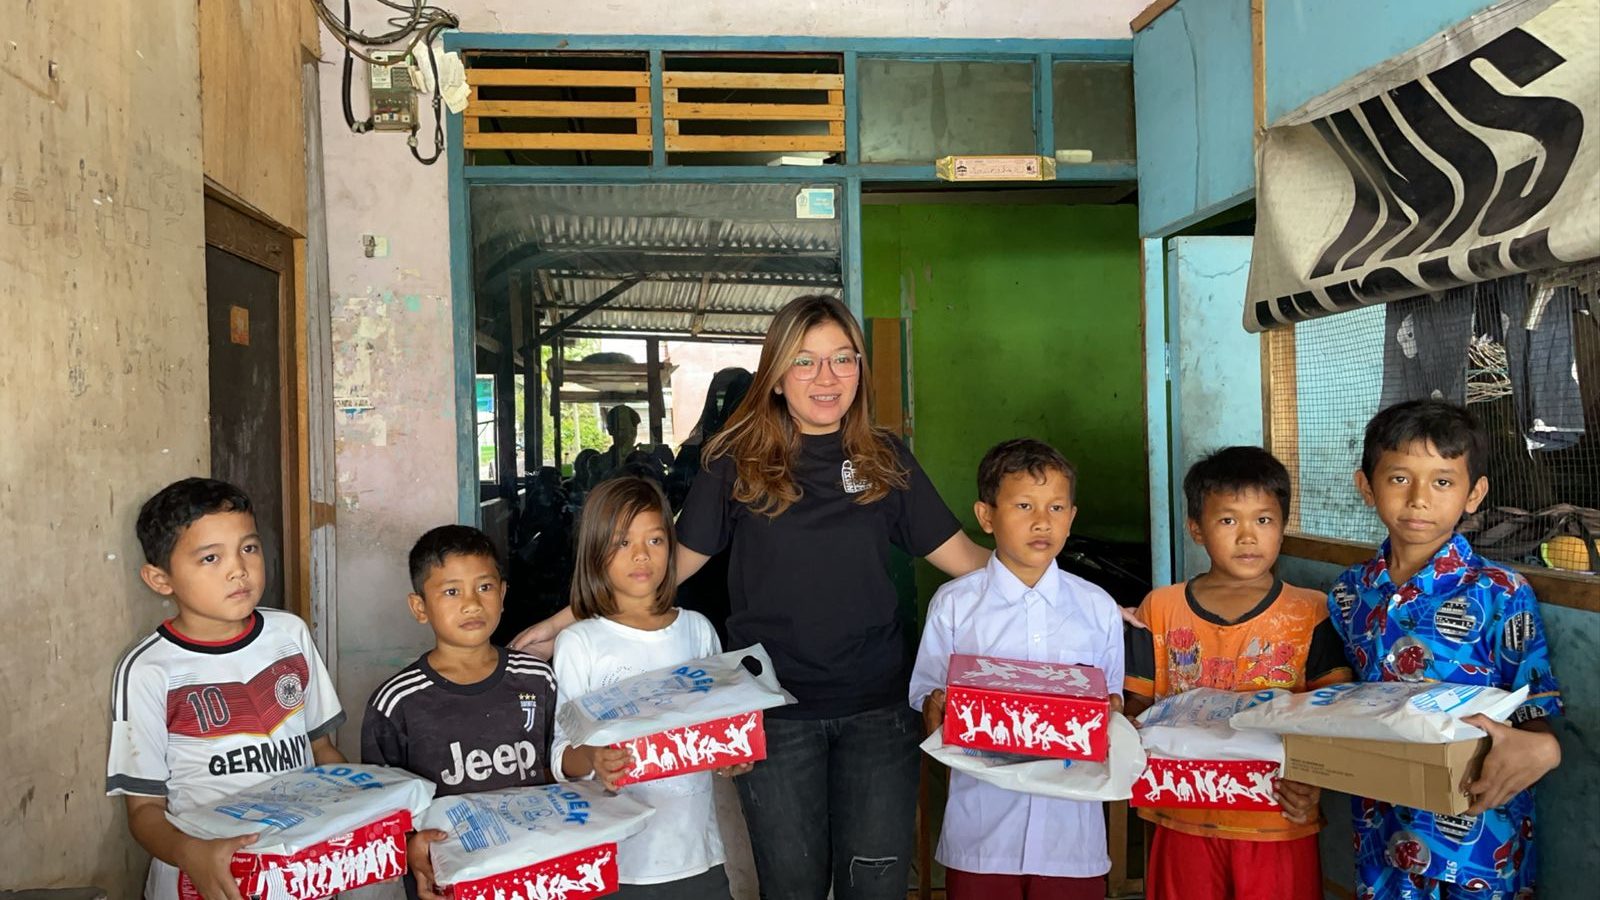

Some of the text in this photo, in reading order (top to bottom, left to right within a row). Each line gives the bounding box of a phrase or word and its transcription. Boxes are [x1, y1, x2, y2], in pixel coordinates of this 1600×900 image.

[187, 686, 231, 733] 10
[209, 734, 307, 776] GERMANY
[440, 740, 537, 785] Jeep
